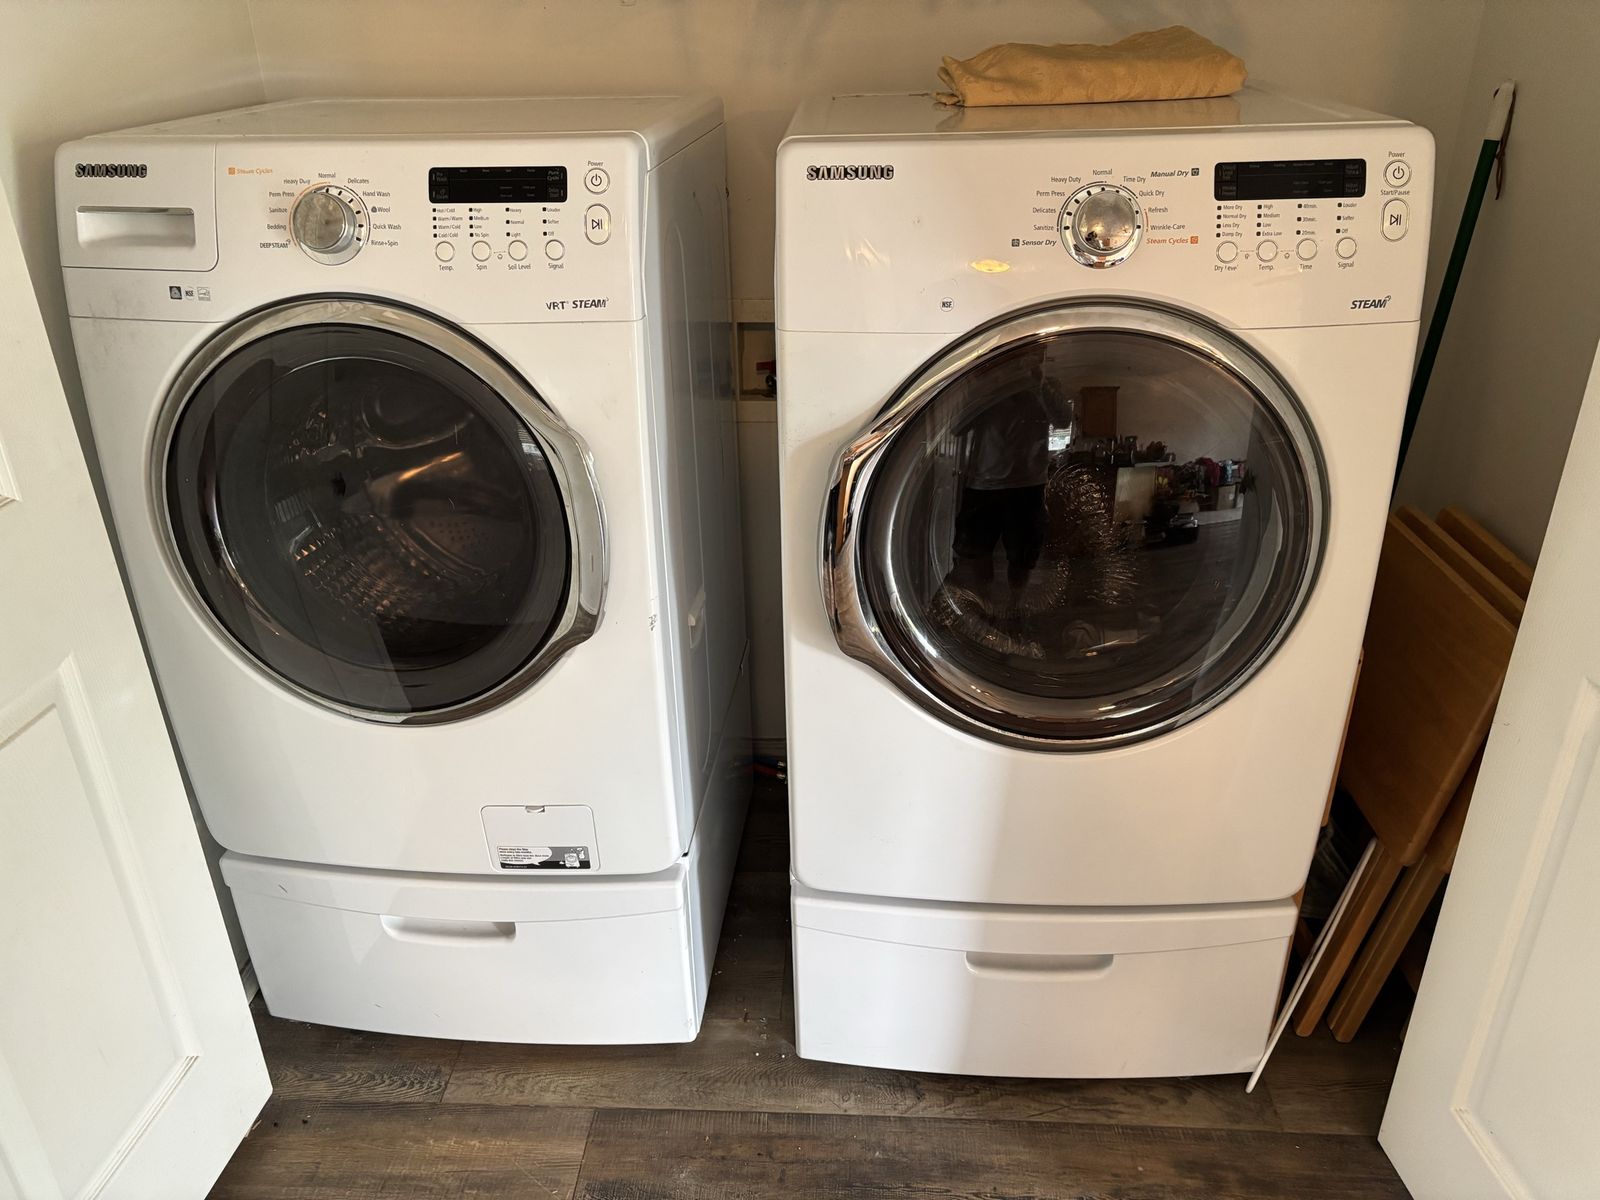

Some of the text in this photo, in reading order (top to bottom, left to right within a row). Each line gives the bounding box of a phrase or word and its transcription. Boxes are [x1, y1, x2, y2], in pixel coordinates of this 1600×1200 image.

[75, 163, 148, 178] SAMSUNG
[806, 165, 894, 180] SAMSUNG
[1150, 169, 1190, 178] Manual Dry
[1051, 175, 1081, 184] Heavy Duty
[1137, 176, 1146, 184] Dry
[1155, 190, 1165, 198] Dry
[267, 223, 287, 231] Bedding
[1045, 239, 1057, 247] Dry
[1168, 237, 1189, 245] Cycles
[1338, 261, 1354, 269] Signal
[546, 299, 607, 310] VRT STEAM
[1350, 300, 1388, 310] STEAM
